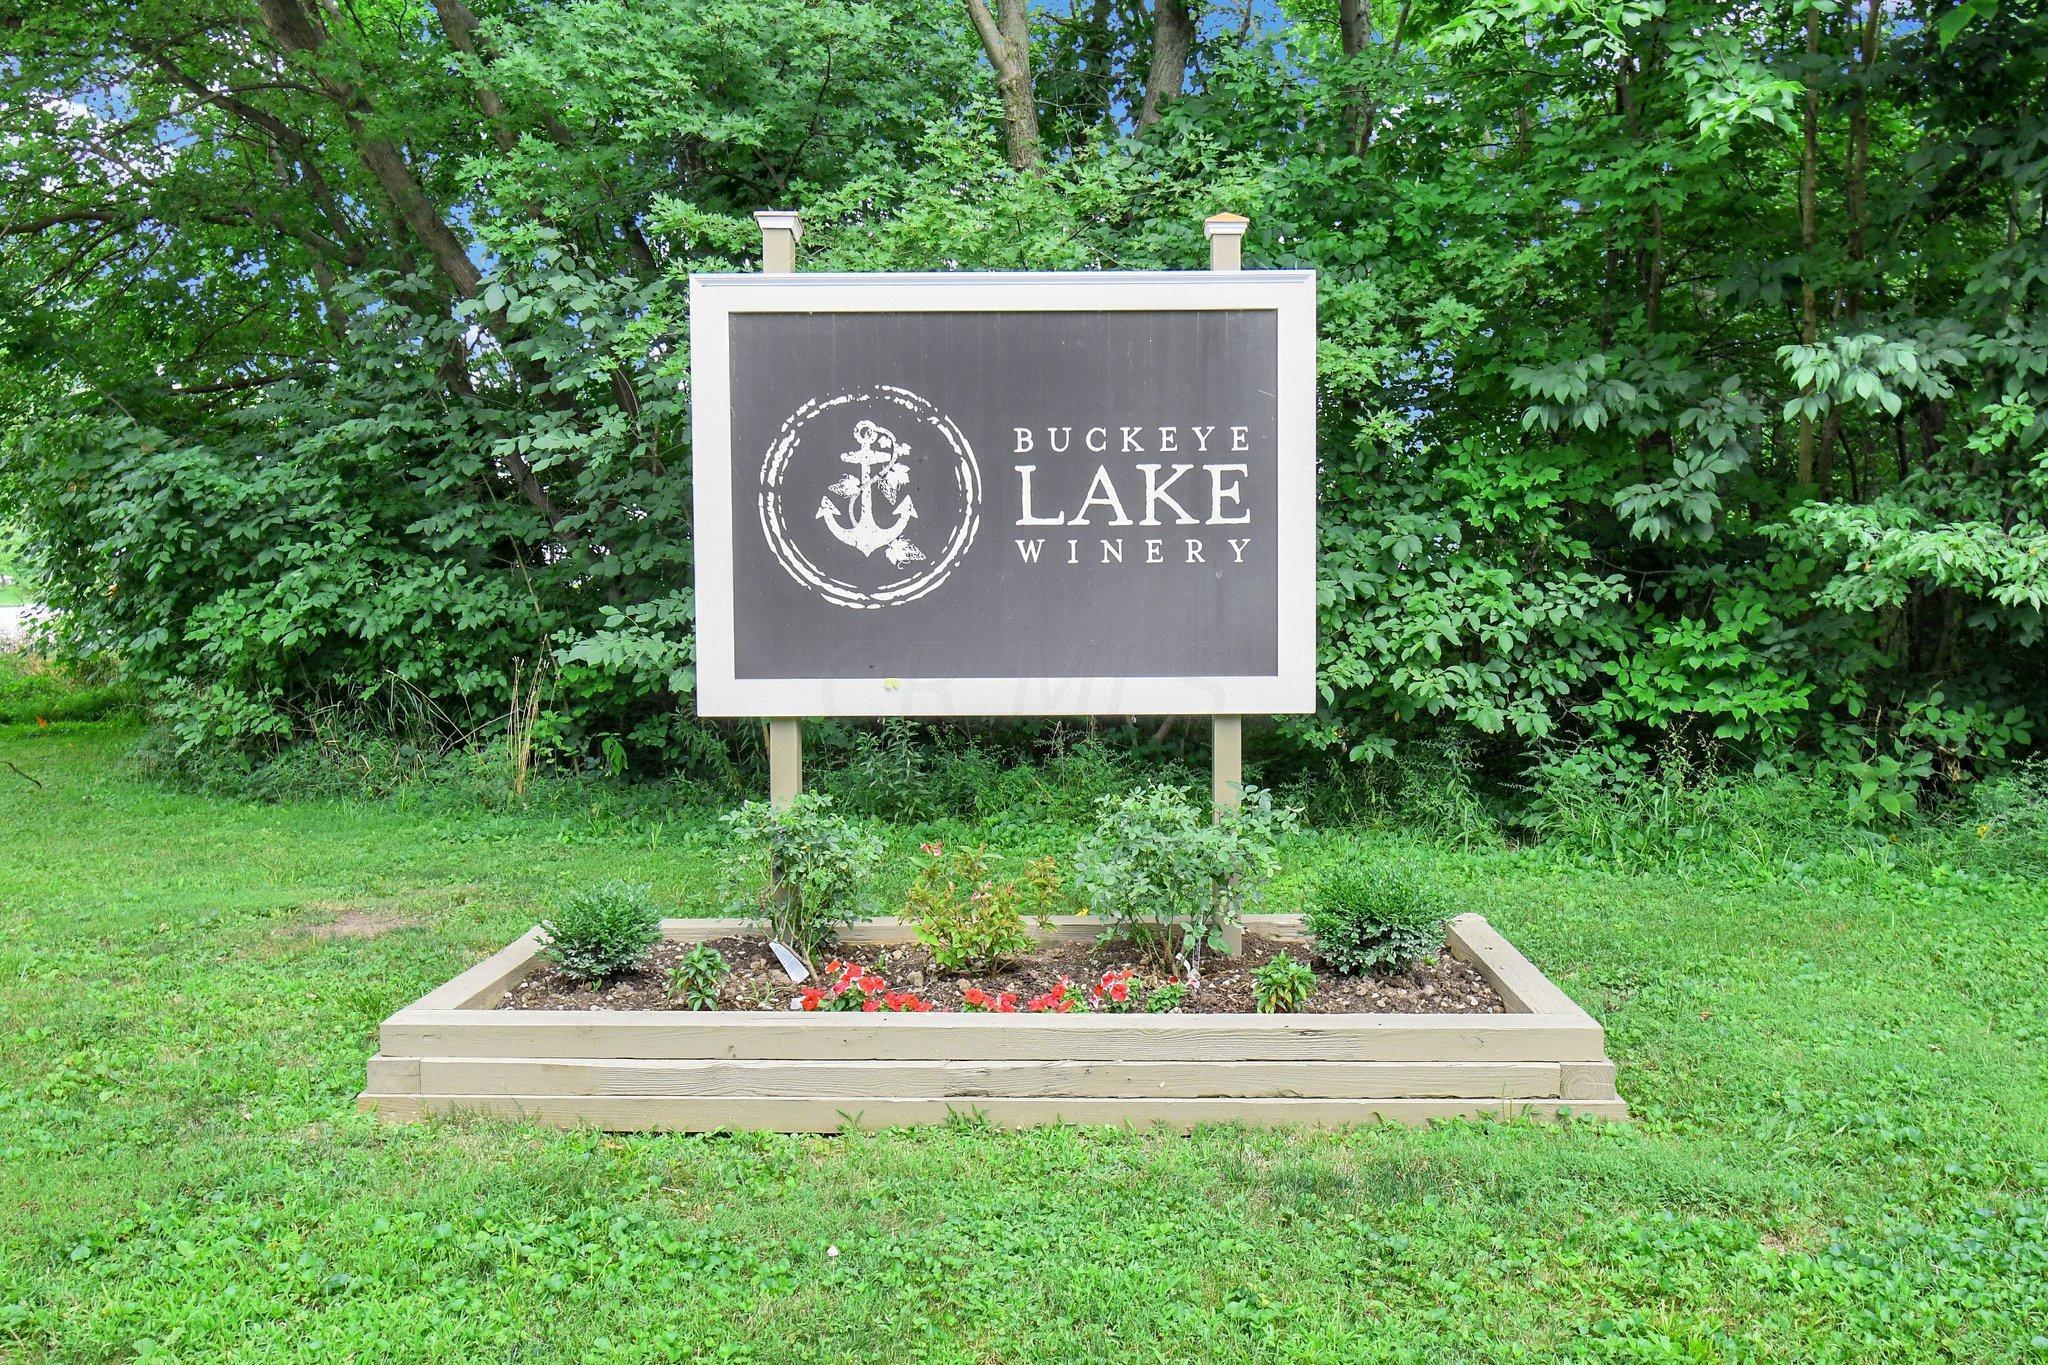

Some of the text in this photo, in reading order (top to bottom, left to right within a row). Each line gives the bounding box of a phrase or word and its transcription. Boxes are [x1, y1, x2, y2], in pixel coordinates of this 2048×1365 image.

[1013, 426, 1249, 453] BUCKEYE
[1014, 463, 1251, 526] LAKE
[1014, 538, 1251, 563] WINERY
